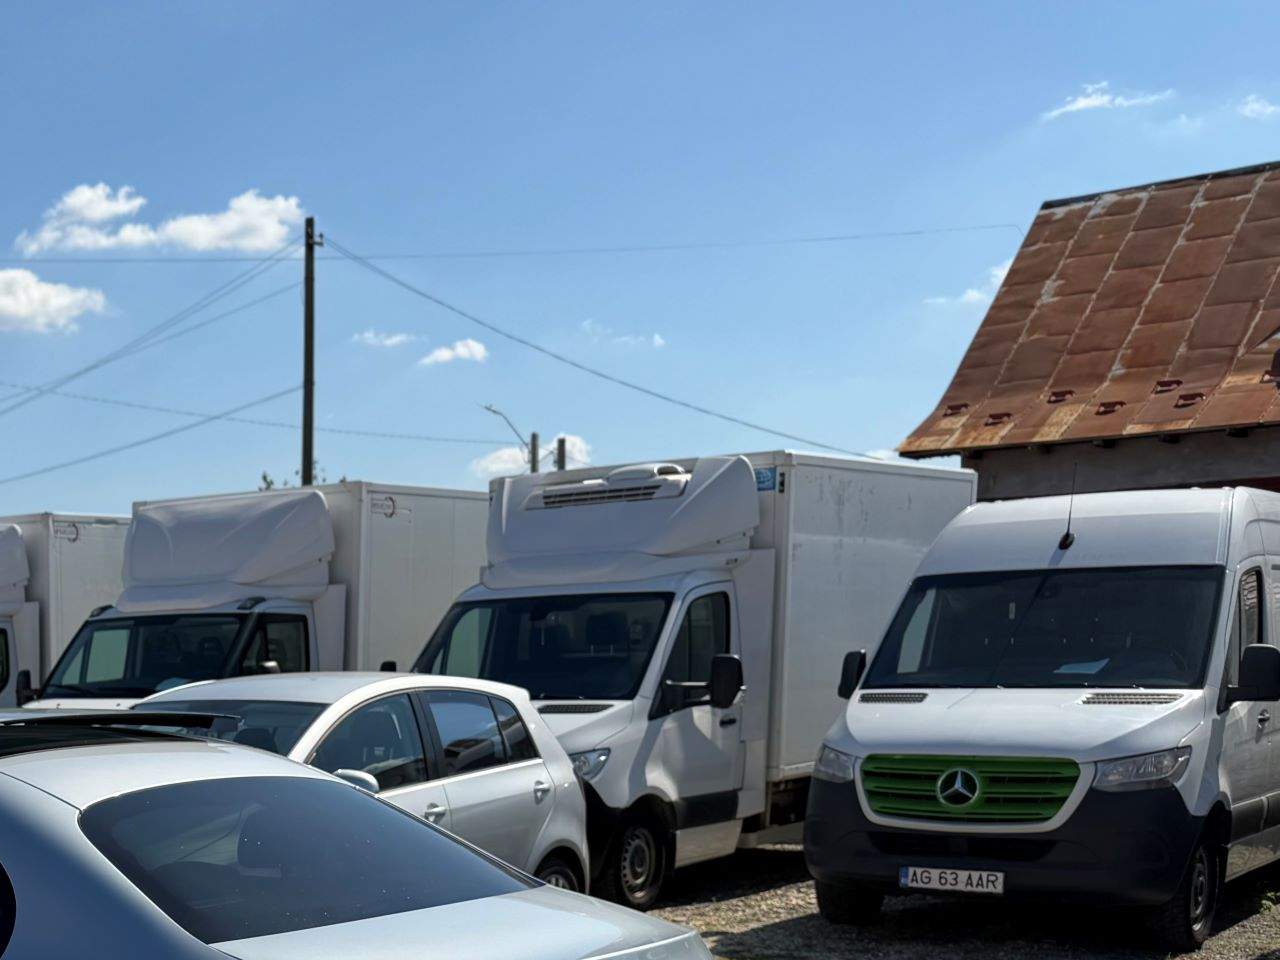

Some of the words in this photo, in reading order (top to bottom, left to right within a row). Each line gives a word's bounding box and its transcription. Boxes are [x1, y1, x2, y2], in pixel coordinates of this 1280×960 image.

[910, 869, 932, 885] AG
[938, 871, 959, 887] 63
[964, 872, 999, 889] AAR
